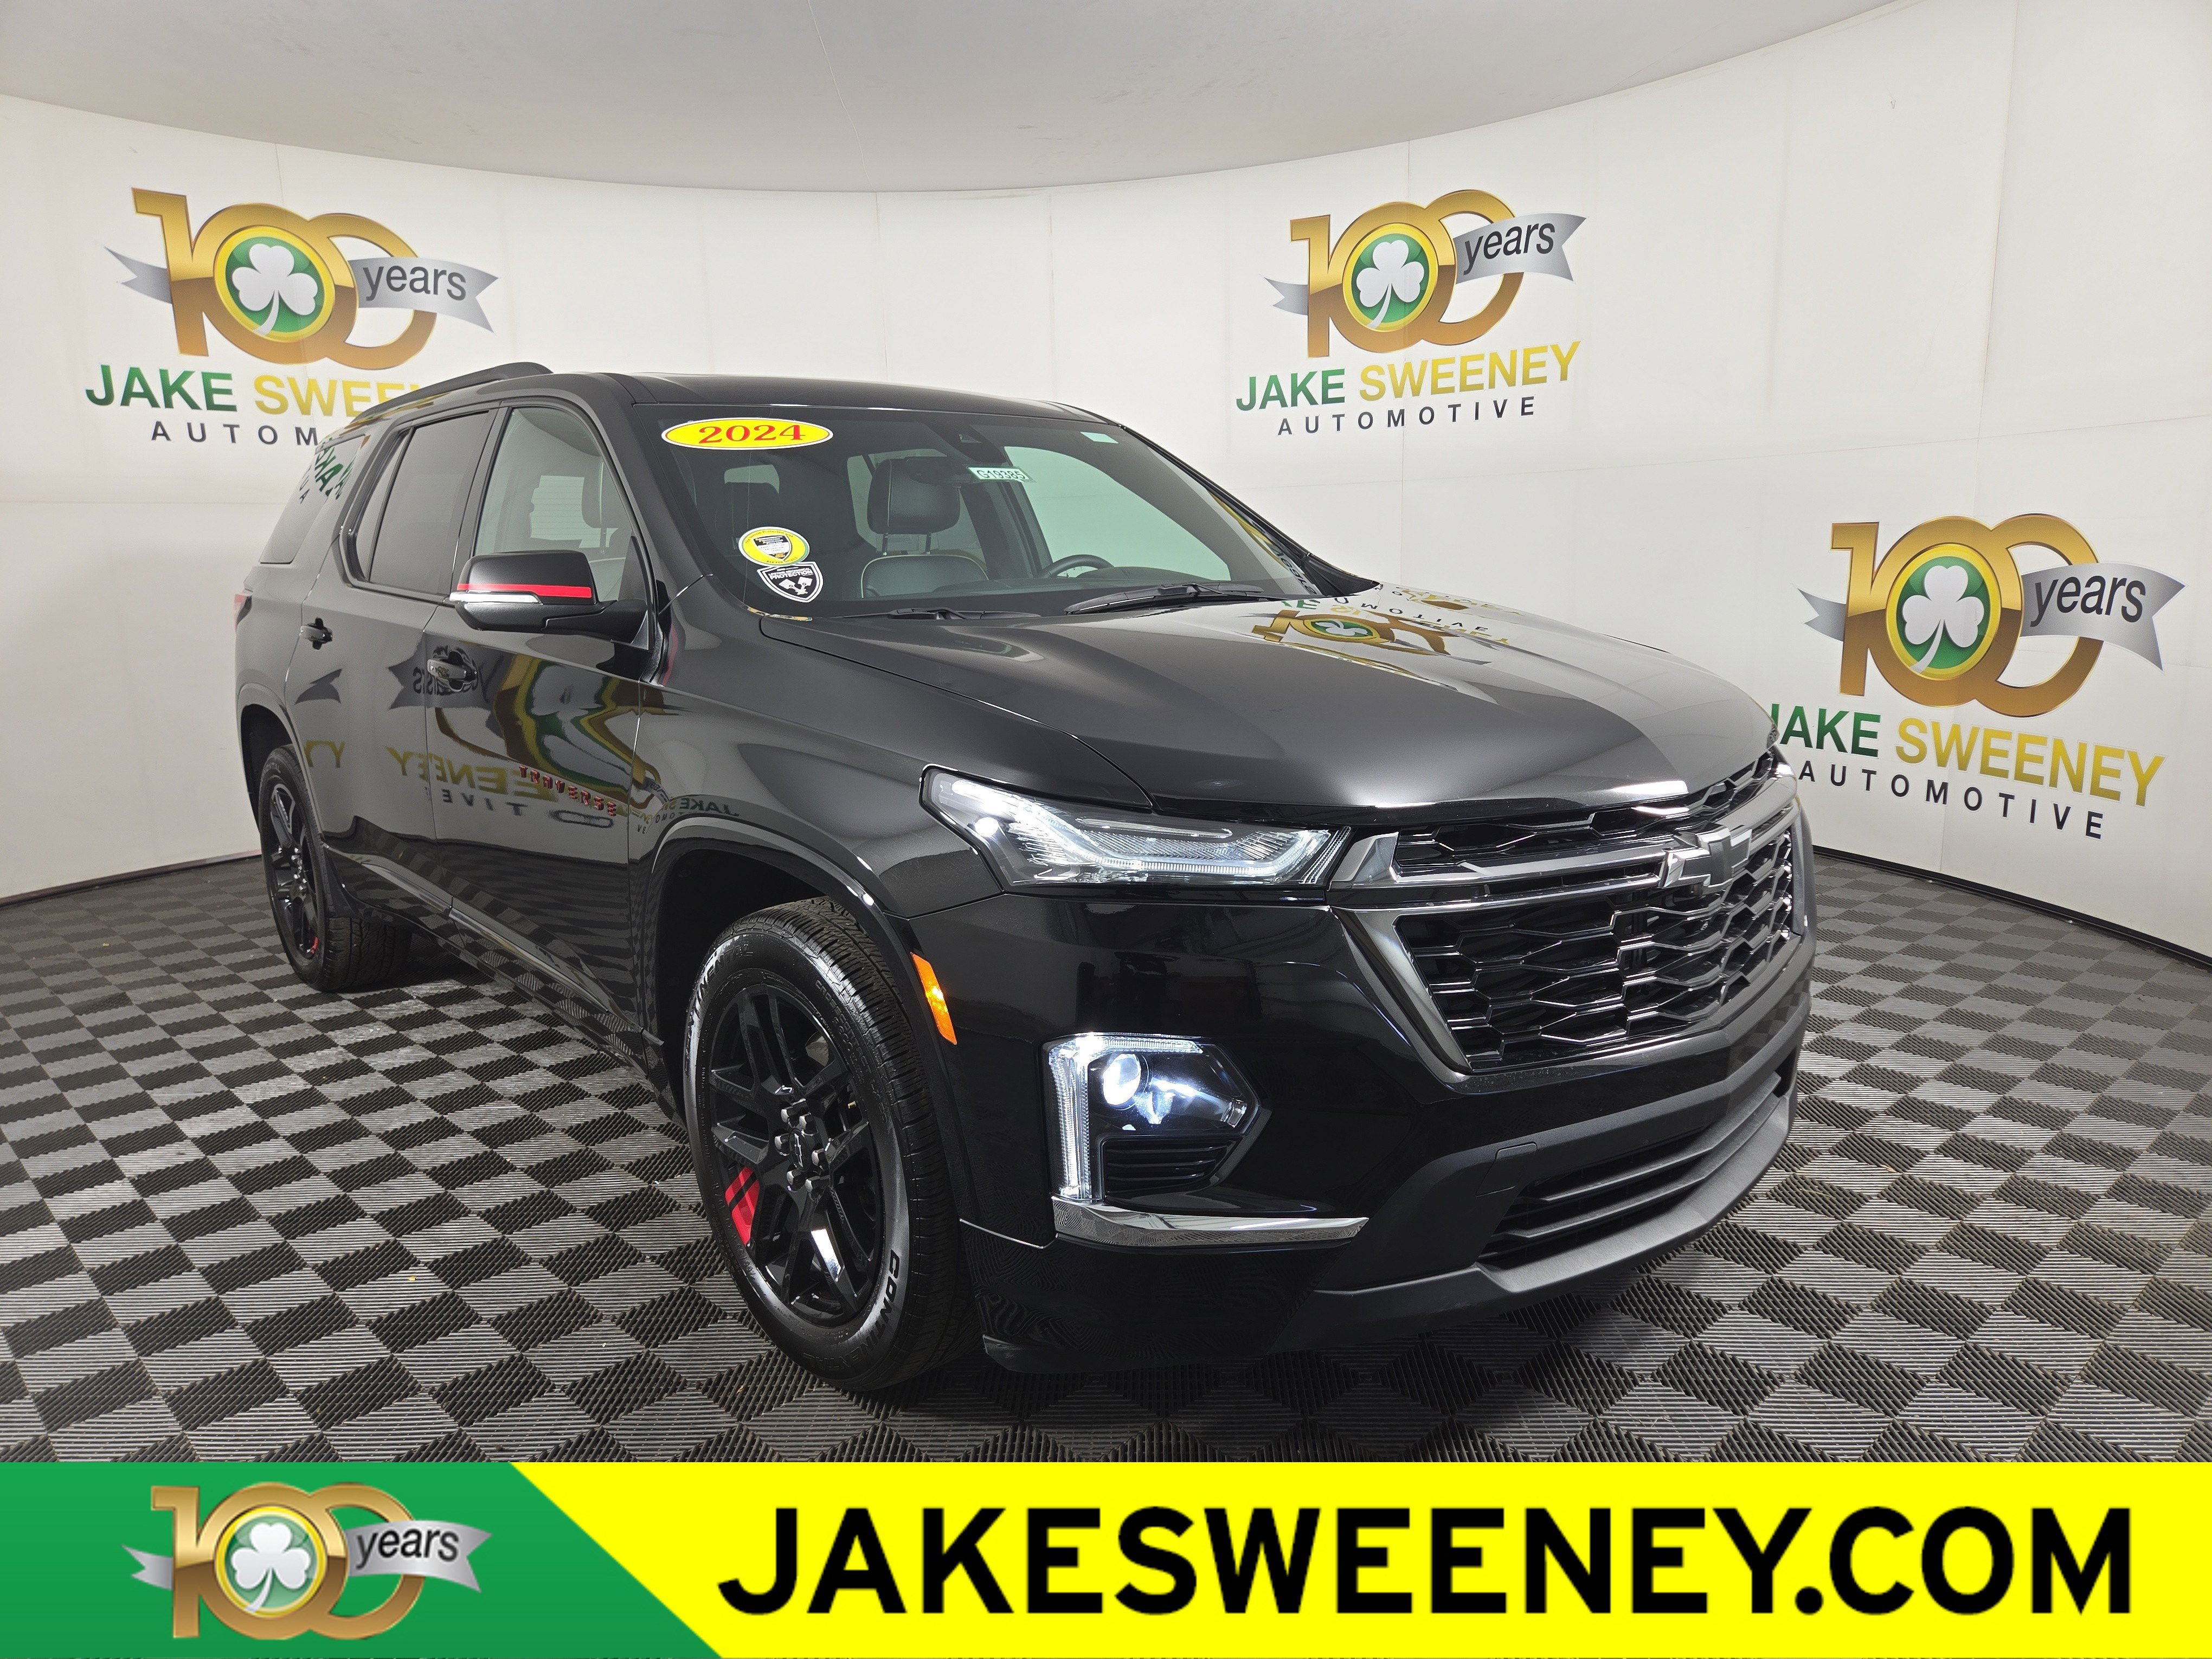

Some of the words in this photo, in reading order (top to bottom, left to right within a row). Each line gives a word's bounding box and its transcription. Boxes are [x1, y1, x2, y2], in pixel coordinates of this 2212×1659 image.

[1464, 221, 1555, 274] years
[362, 264, 467, 301] years
[86, 364, 237, 412] JAKE
[1236, 368, 1345, 411] JAKE
[1359, 341, 1581, 402] SWEENEY
[151, 421, 318, 446] AUTOM
[699, 425, 805, 443] 2024
[1277, 396, 1534, 436] AUTOMOTIVE
[976, 470, 1026, 480] G19385
[769, 569, 814, 580] PROTECTION
[2030, 575, 2146, 627] years
[1896, 718, 2165, 807] SWEENEY
[519, 764, 618, 817] TRAVERSE
[1798, 760, 2103, 839] AUTOMOTIVE
